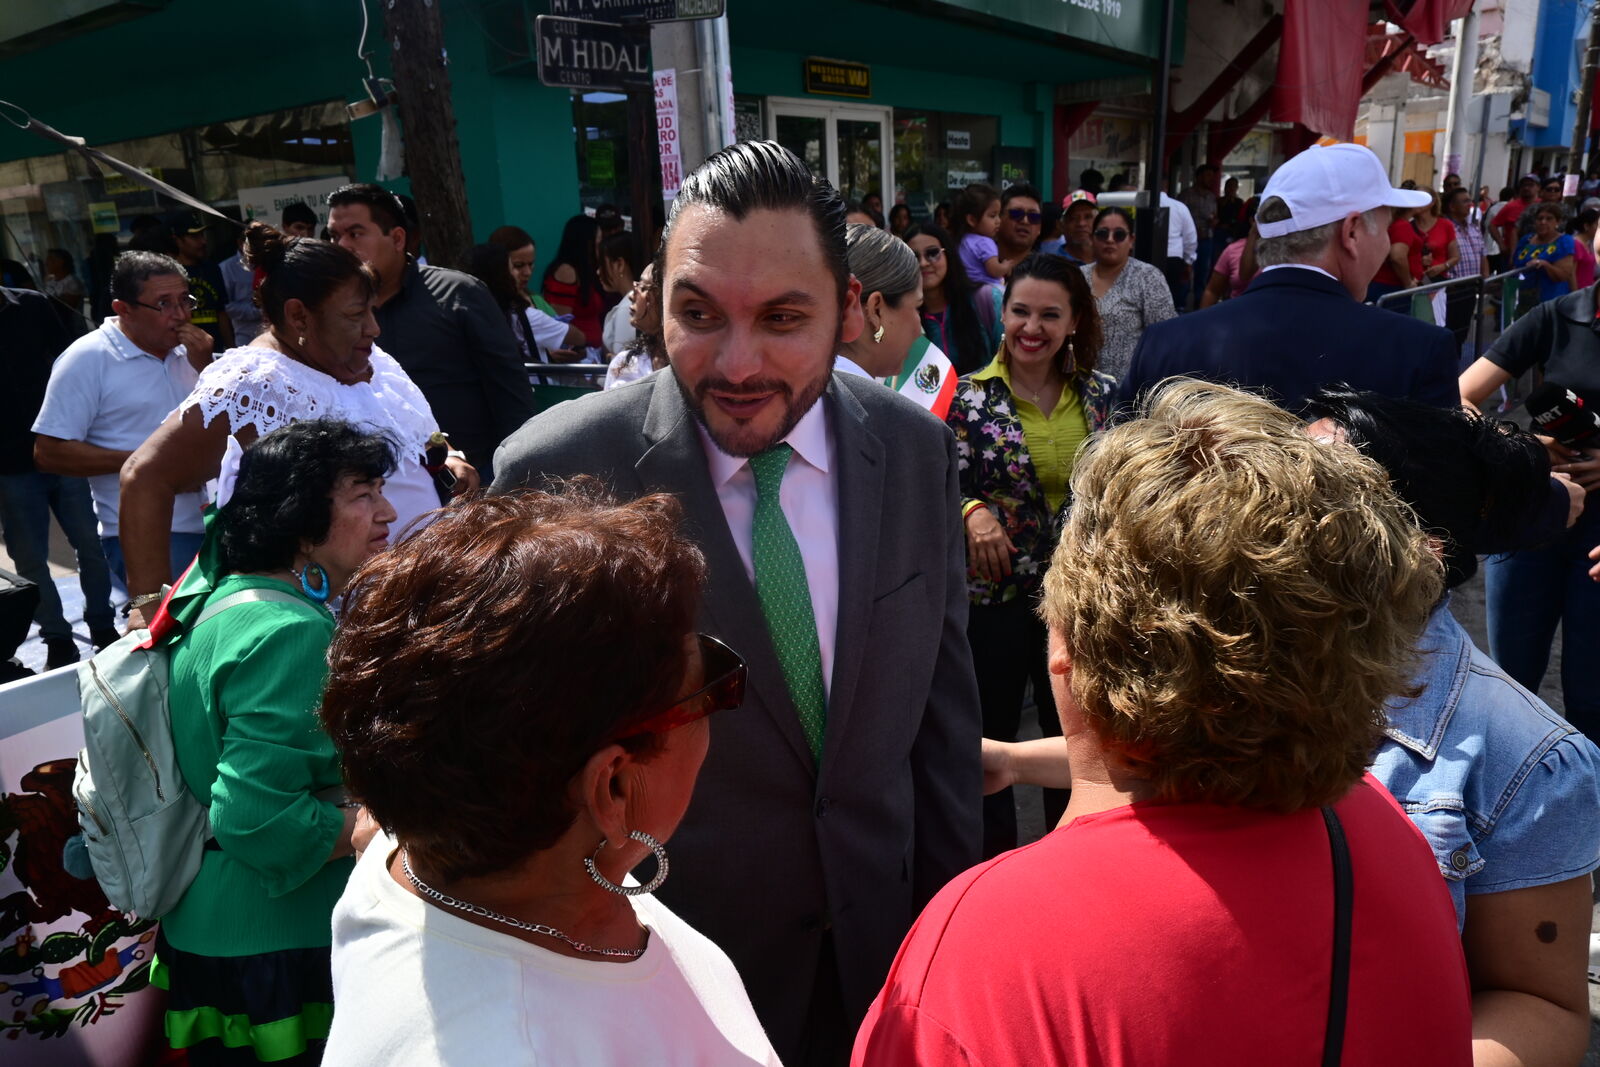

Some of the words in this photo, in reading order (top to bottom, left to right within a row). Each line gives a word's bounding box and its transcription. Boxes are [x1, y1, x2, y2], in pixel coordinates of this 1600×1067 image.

[560, 71, 592, 84] CENTRO
[661, 76, 673, 87] DE
[948, 134, 969, 147] Hasta
